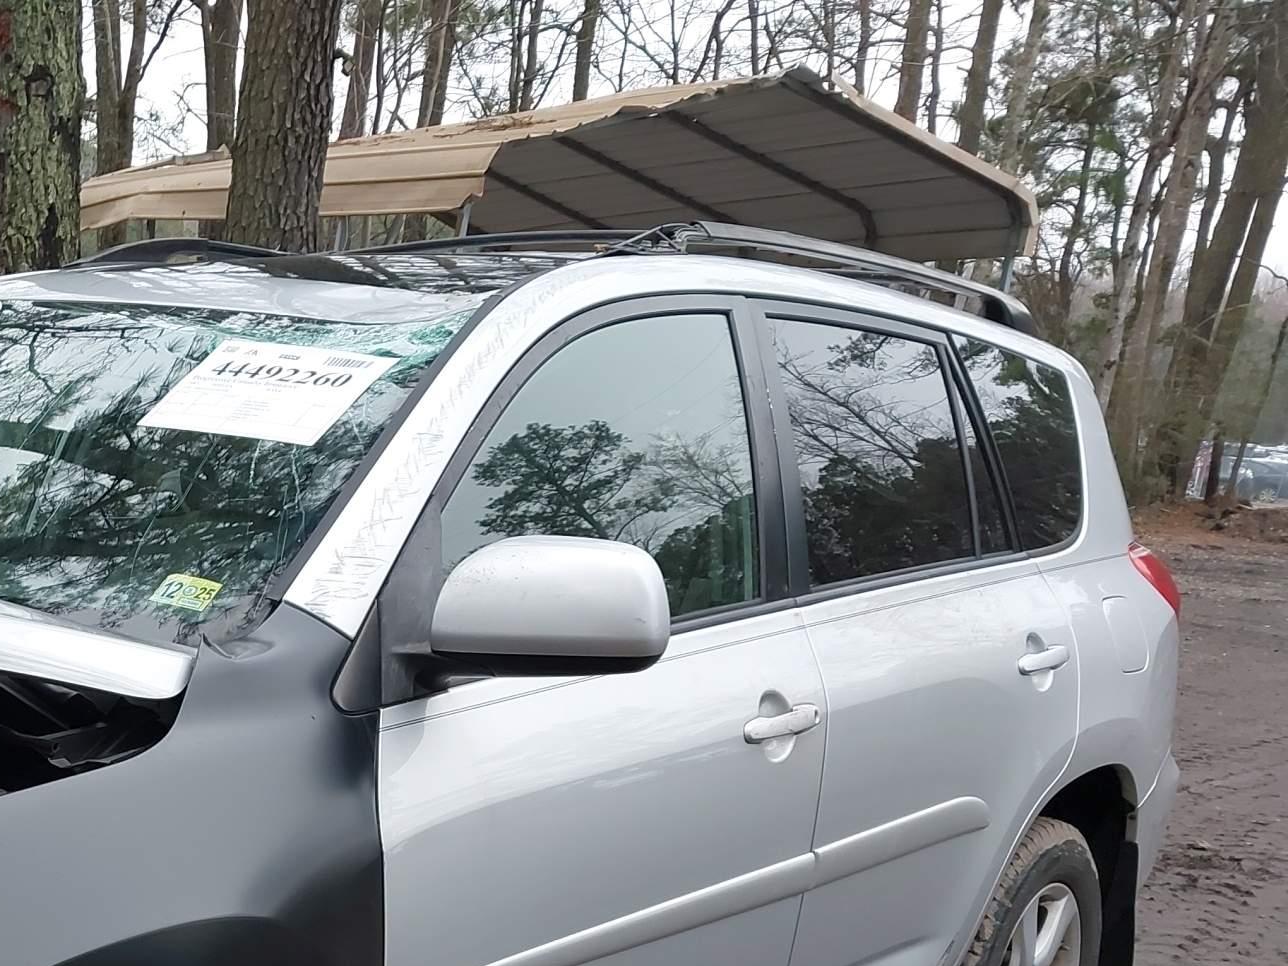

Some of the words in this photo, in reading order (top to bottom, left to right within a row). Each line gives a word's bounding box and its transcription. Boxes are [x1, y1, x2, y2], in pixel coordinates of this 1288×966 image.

[212, 361, 353, 388] 44492260
[161, 581, 184, 598] 12
[194, 587, 216, 601] 25
